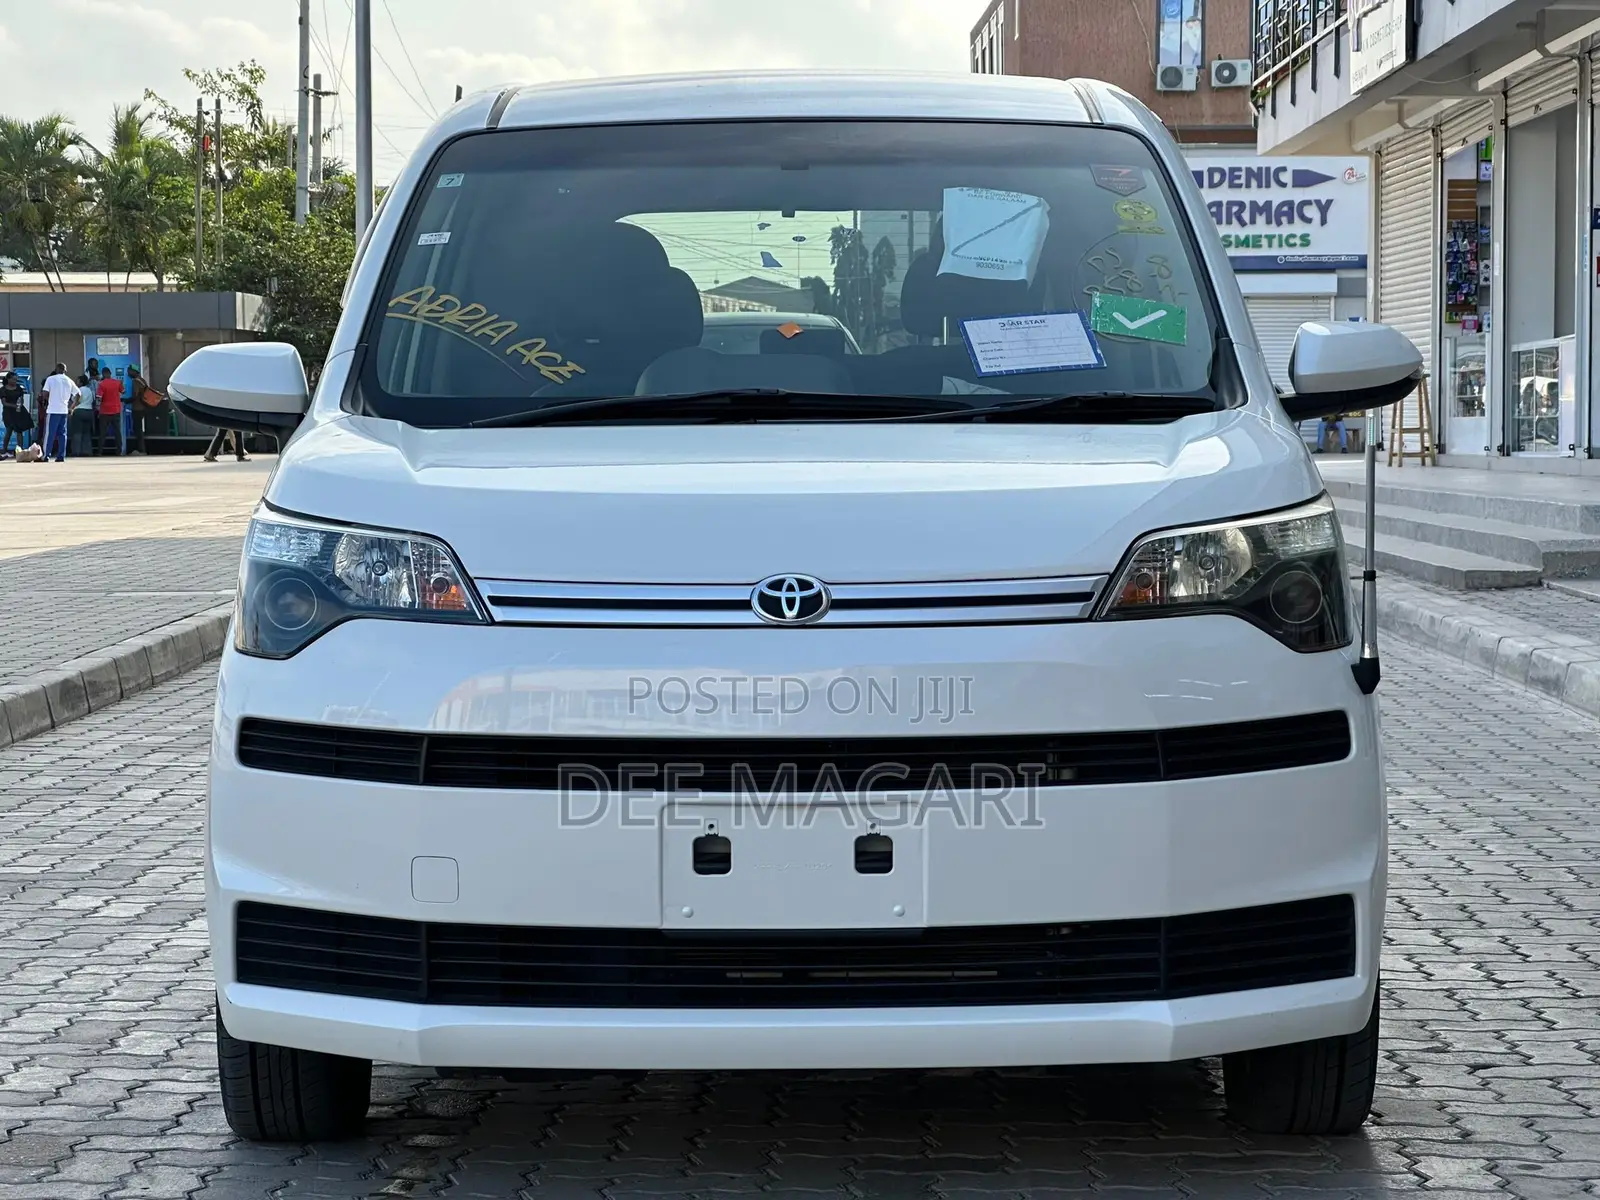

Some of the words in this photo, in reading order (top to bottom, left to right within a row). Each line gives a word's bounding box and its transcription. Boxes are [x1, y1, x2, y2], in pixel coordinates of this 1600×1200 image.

[1207, 165, 1288, 189] DENIC
[1207, 199, 1334, 227] ARMACY
[1221, 232, 1311, 249] SMETICS
